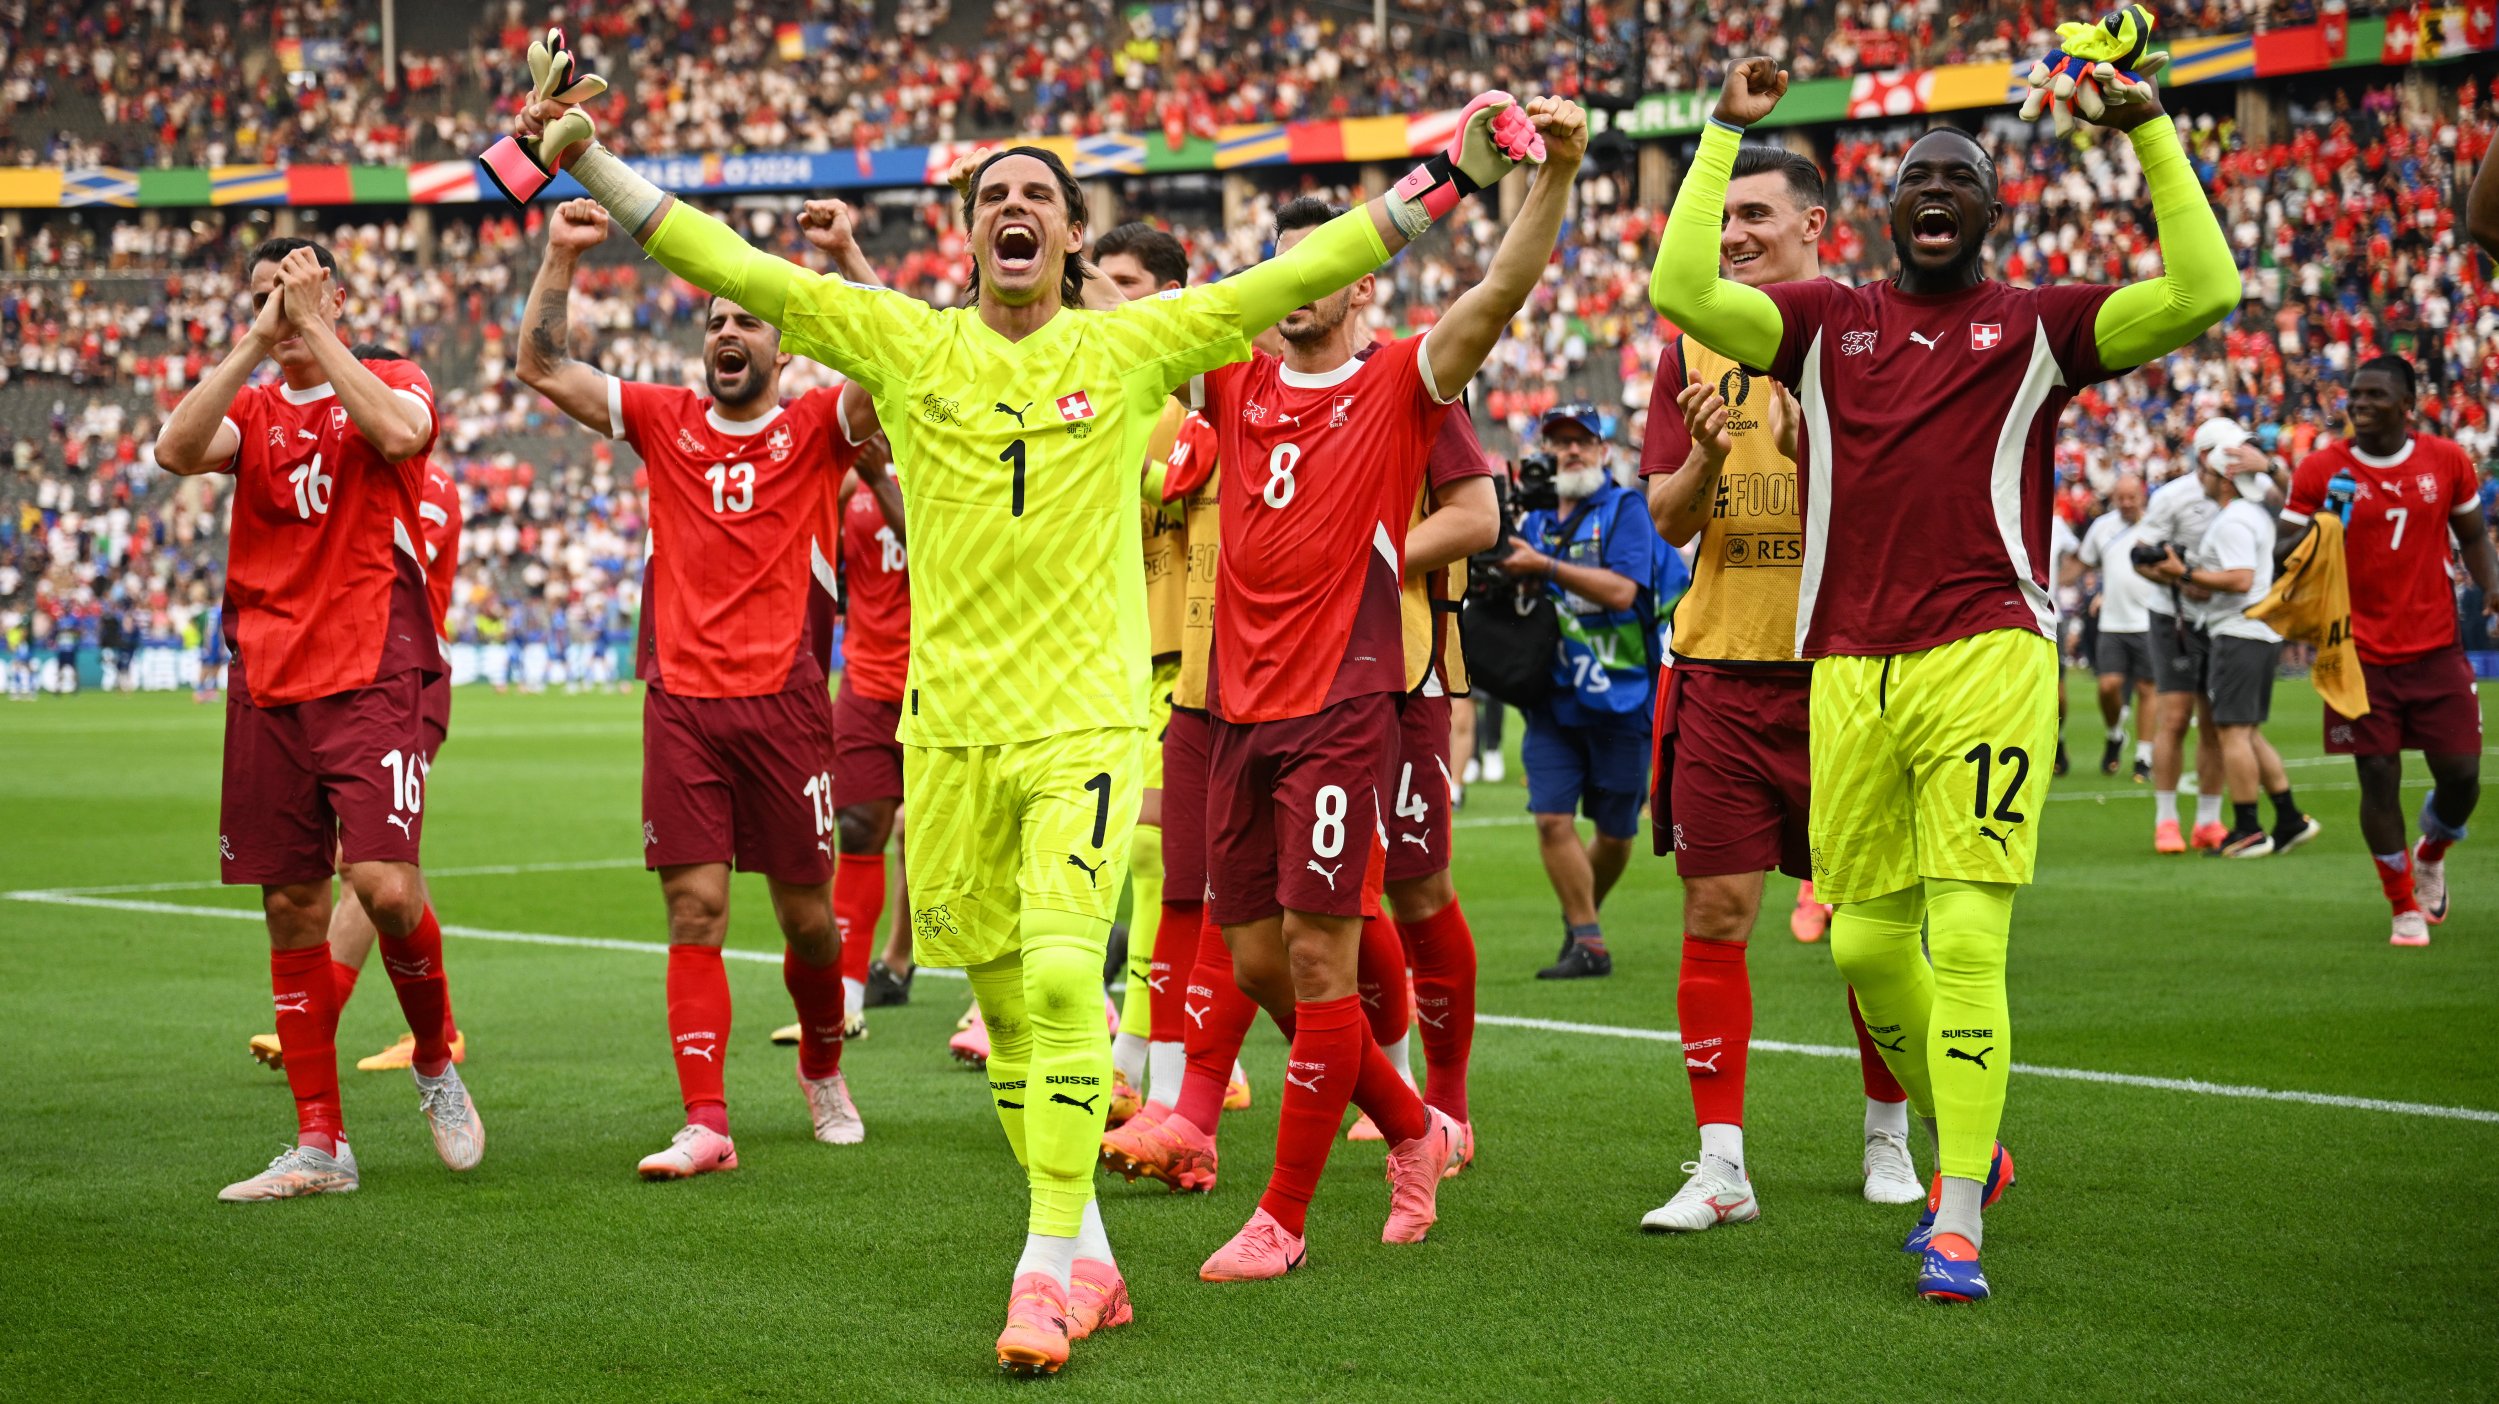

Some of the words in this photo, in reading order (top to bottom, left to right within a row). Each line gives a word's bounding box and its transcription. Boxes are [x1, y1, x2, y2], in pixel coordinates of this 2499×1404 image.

[288, 452, 333, 519] 16
[704, 461, 756, 514] 13
[999, 439, 1026, 518] 1
[1263, 442, 1301, 509] 8
[2386, 508, 2408, 550] 7
[380, 749, 421, 815] 16
[802, 771, 834, 837] 13
[1084, 772, 1112, 850] 1
[1395, 761, 1428, 823] 4
[1964, 742, 2030, 824] 12
[1311, 784, 1348, 859] 8
[676, 1031, 717, 1043] SUISSE
[1682, 1037, 1723, 1051] SUISSE
[1941, 1029, 1994, 1039] SUISSE
[990, 1080, 1027, 1091] SUISS
[1045, 1075, 1100, 1086] SUISSE
